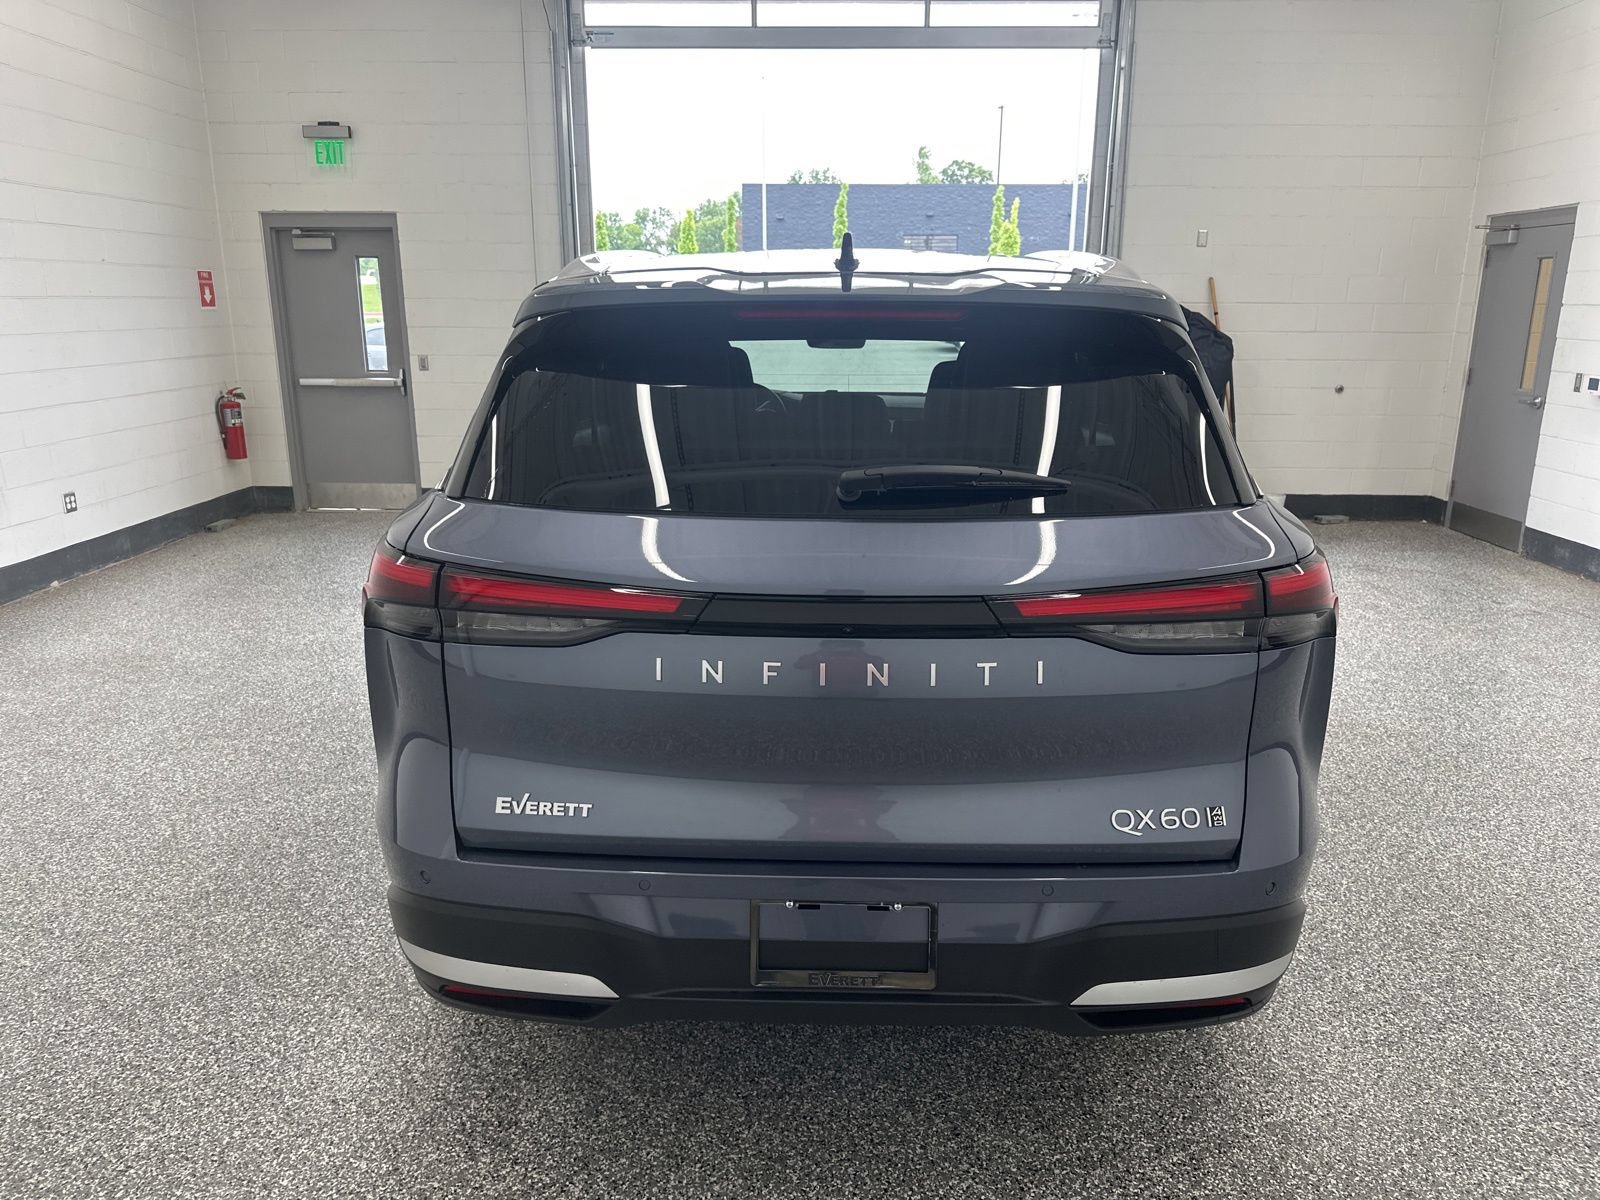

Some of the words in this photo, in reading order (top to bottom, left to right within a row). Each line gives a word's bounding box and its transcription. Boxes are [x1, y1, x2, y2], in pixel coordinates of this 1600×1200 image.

[315, 141, 344, 164] EXIT
[655, 657, 1043, 687] INFINITI
[495, 793, 593, 817] EVERETT
[1110, 807, 1200, 836] QX60
